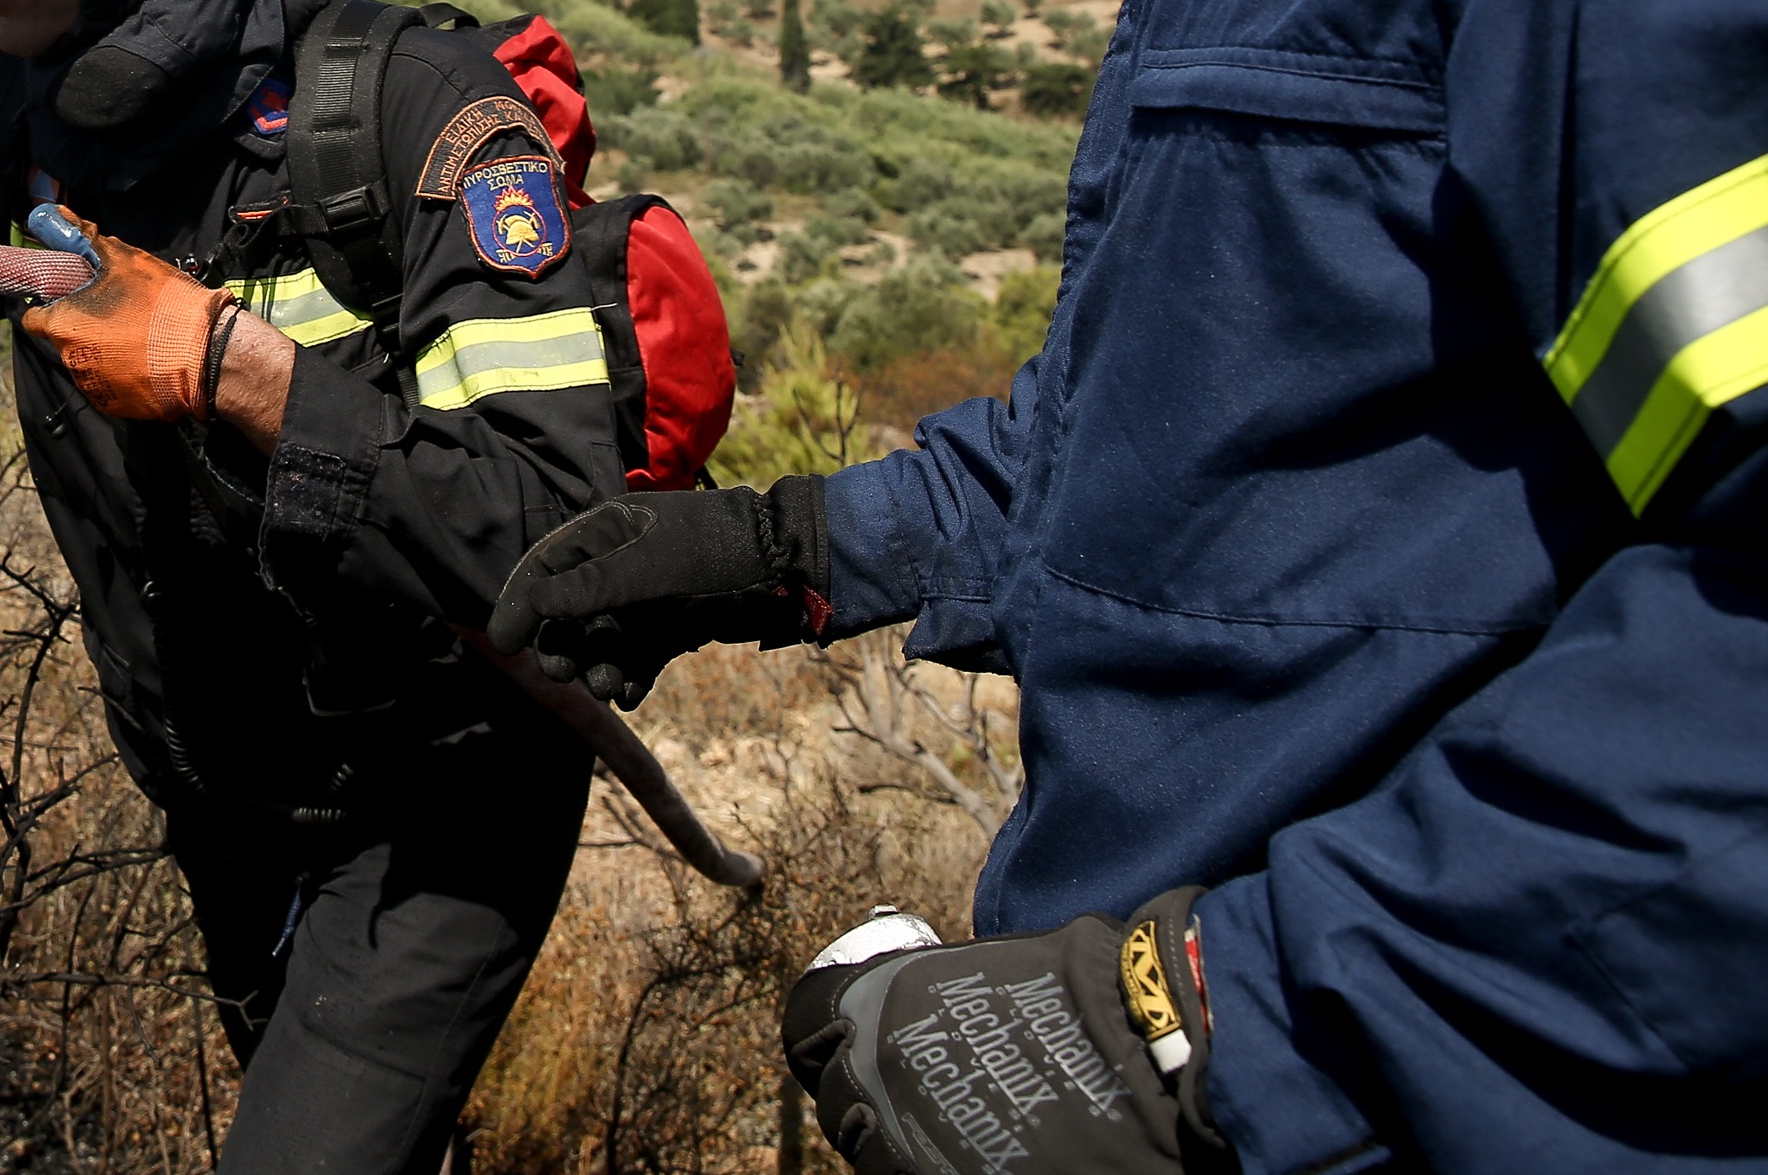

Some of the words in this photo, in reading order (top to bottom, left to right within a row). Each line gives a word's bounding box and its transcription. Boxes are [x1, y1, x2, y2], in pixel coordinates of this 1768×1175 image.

[445, 107, 484, 144] ΕΙΔΙΚΗ
[463, 161, 548, 189] ΠΥΡΟΣΒΕΣΤΙΚΟ
[487, 173, 524, 191] ΣΩΜΑ
[935, 972, 1060, 1116] Mechanix
[1004, 972, 1131, 1113] Mechanix
[893, 1014, 1030, 1171] Mechanix
